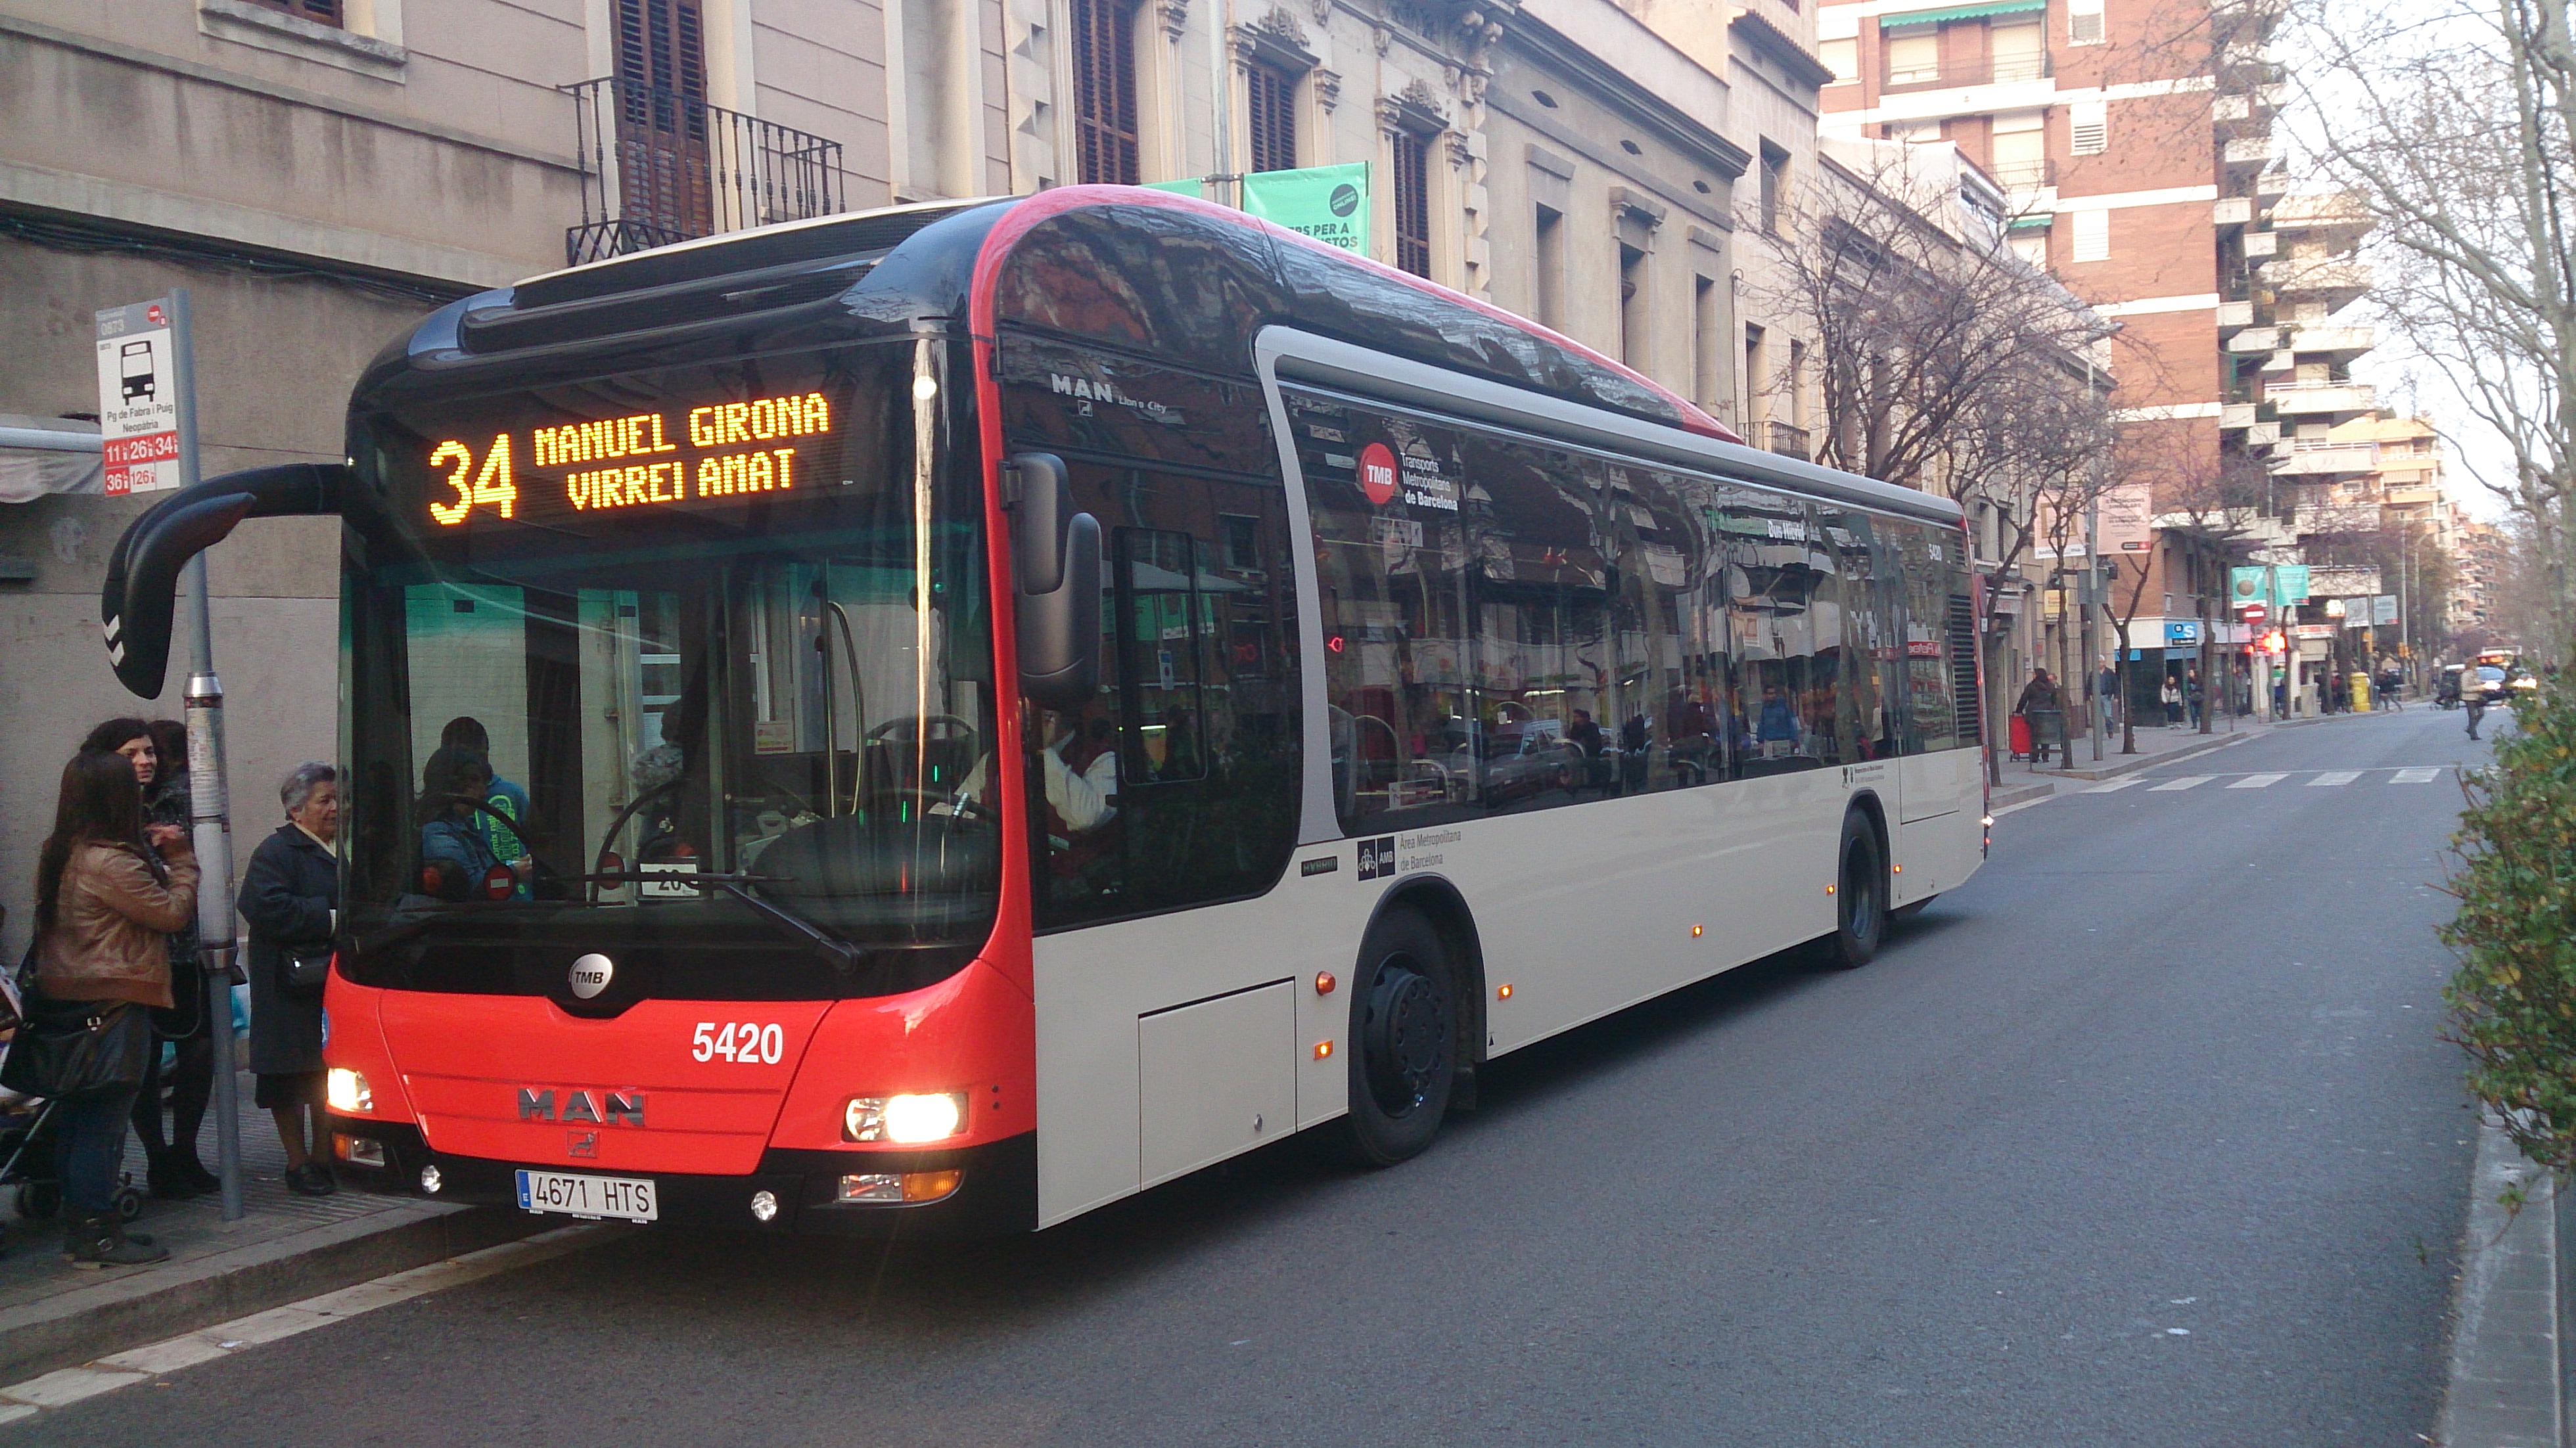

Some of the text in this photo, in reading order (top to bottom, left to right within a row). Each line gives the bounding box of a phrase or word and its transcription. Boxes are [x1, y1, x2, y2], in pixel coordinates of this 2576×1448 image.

[1314, 223, 1337, 236] PER
[1341, 222, 1350, 234] A
[1051, 373, 1113, 403] MAN
[1147, 401, 1167, 414] City
[107, 411, 117, 422] Pg
[118, 410, 127, 419] de
[129, 407, 150, 418] Fabra
[156, 403, 173, 414] Puig
[123, 419, 158, 433] Neopàtria
[534, 392, 829, 466] MANUEL GIRONA
[107, 445, 120, 463] 11
[130, 440, 147, 459] 26
[156, 436, 173, 455] 34
[1400, 452, 1439, 473] Transports
[106, 474, 123, 491] 36
[131, 470, 150, 486] 126
[430, 434, 517, 524] 34
[567, 449, 794, 510] VIRREI AMAT
[1367, 464, 1392, 485] TMB
[1402, 470, 1451, 491] Metropolitans
[1405, 489, 1458, 511] de Barcelona
[1400, 830, 1461, 850] Àrea Metropolitana
[1380, 850, 1394, 865] AMB
[1400, 853, 1443, 871] de Barcelona
[575, 972, 604, 985] TMB
[692, 1022, 784, 1064] 5420
[518, 1088, 645, 1126] MAN
[536, 1177, 650, 1213] 4671 HTS
